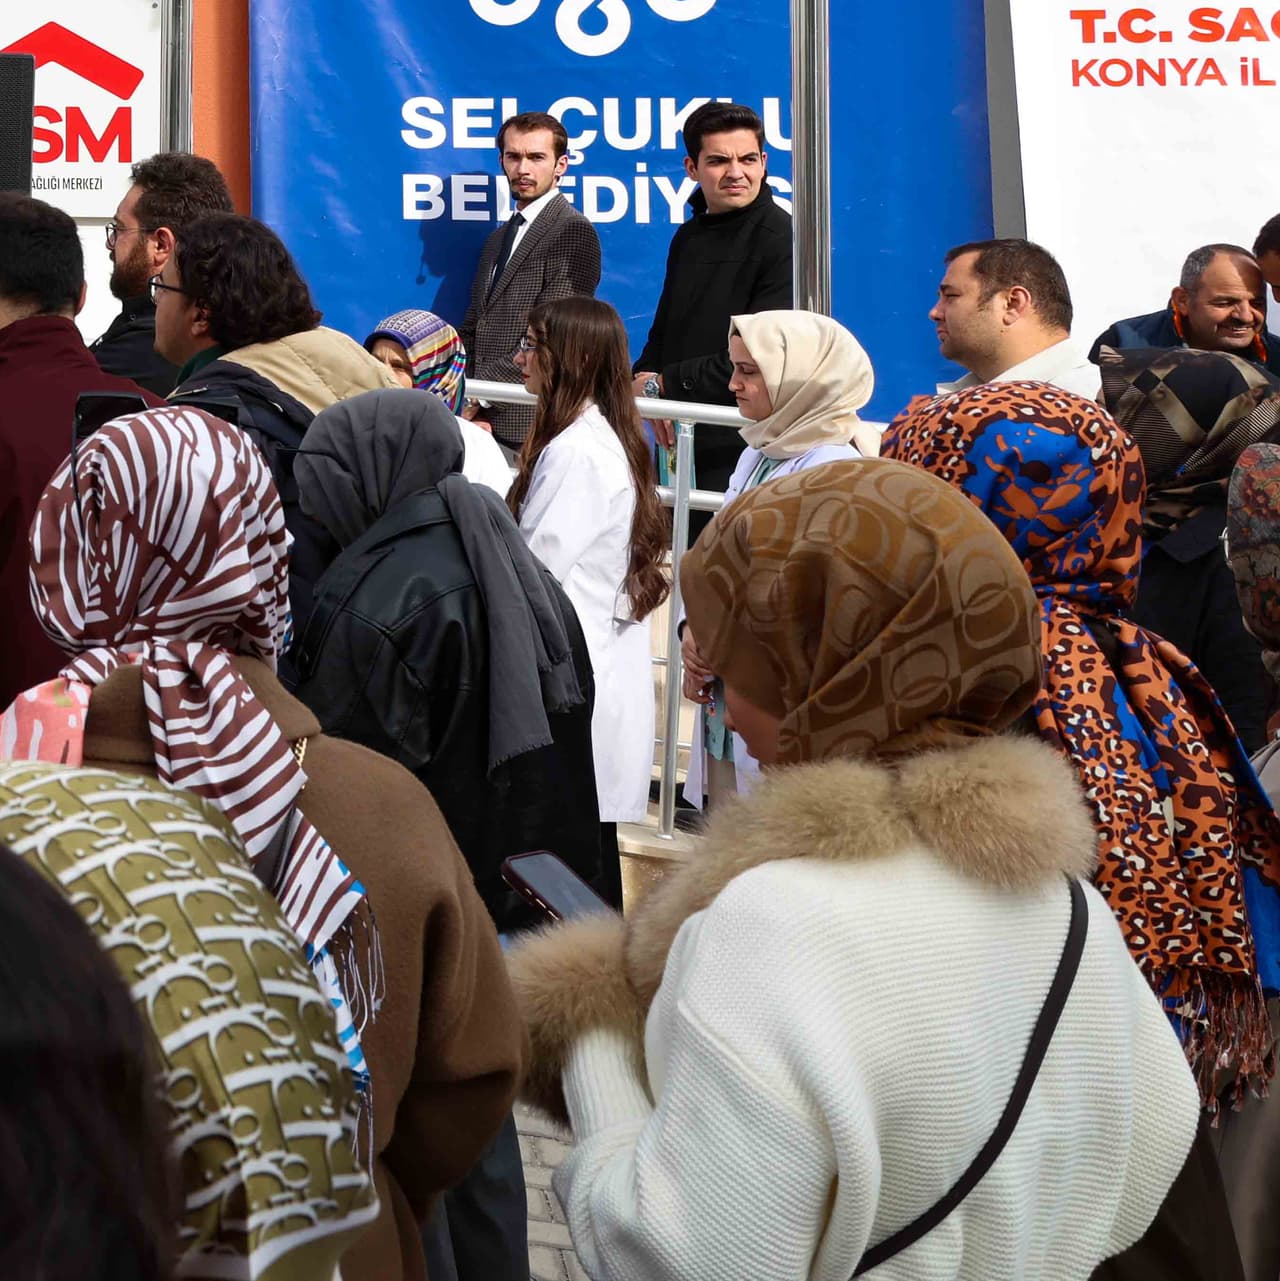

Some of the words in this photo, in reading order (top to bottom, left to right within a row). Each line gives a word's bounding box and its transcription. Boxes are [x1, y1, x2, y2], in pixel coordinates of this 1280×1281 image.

[1069, 8, 1173, 44] T.C.
[1187, 7, 1280, 43] SA
[1071, 58, 1228, 87] KONYA
[31, 175, 60, 190] AĞLIĞI
[62, 176, 103, 190] MERKEZİ
